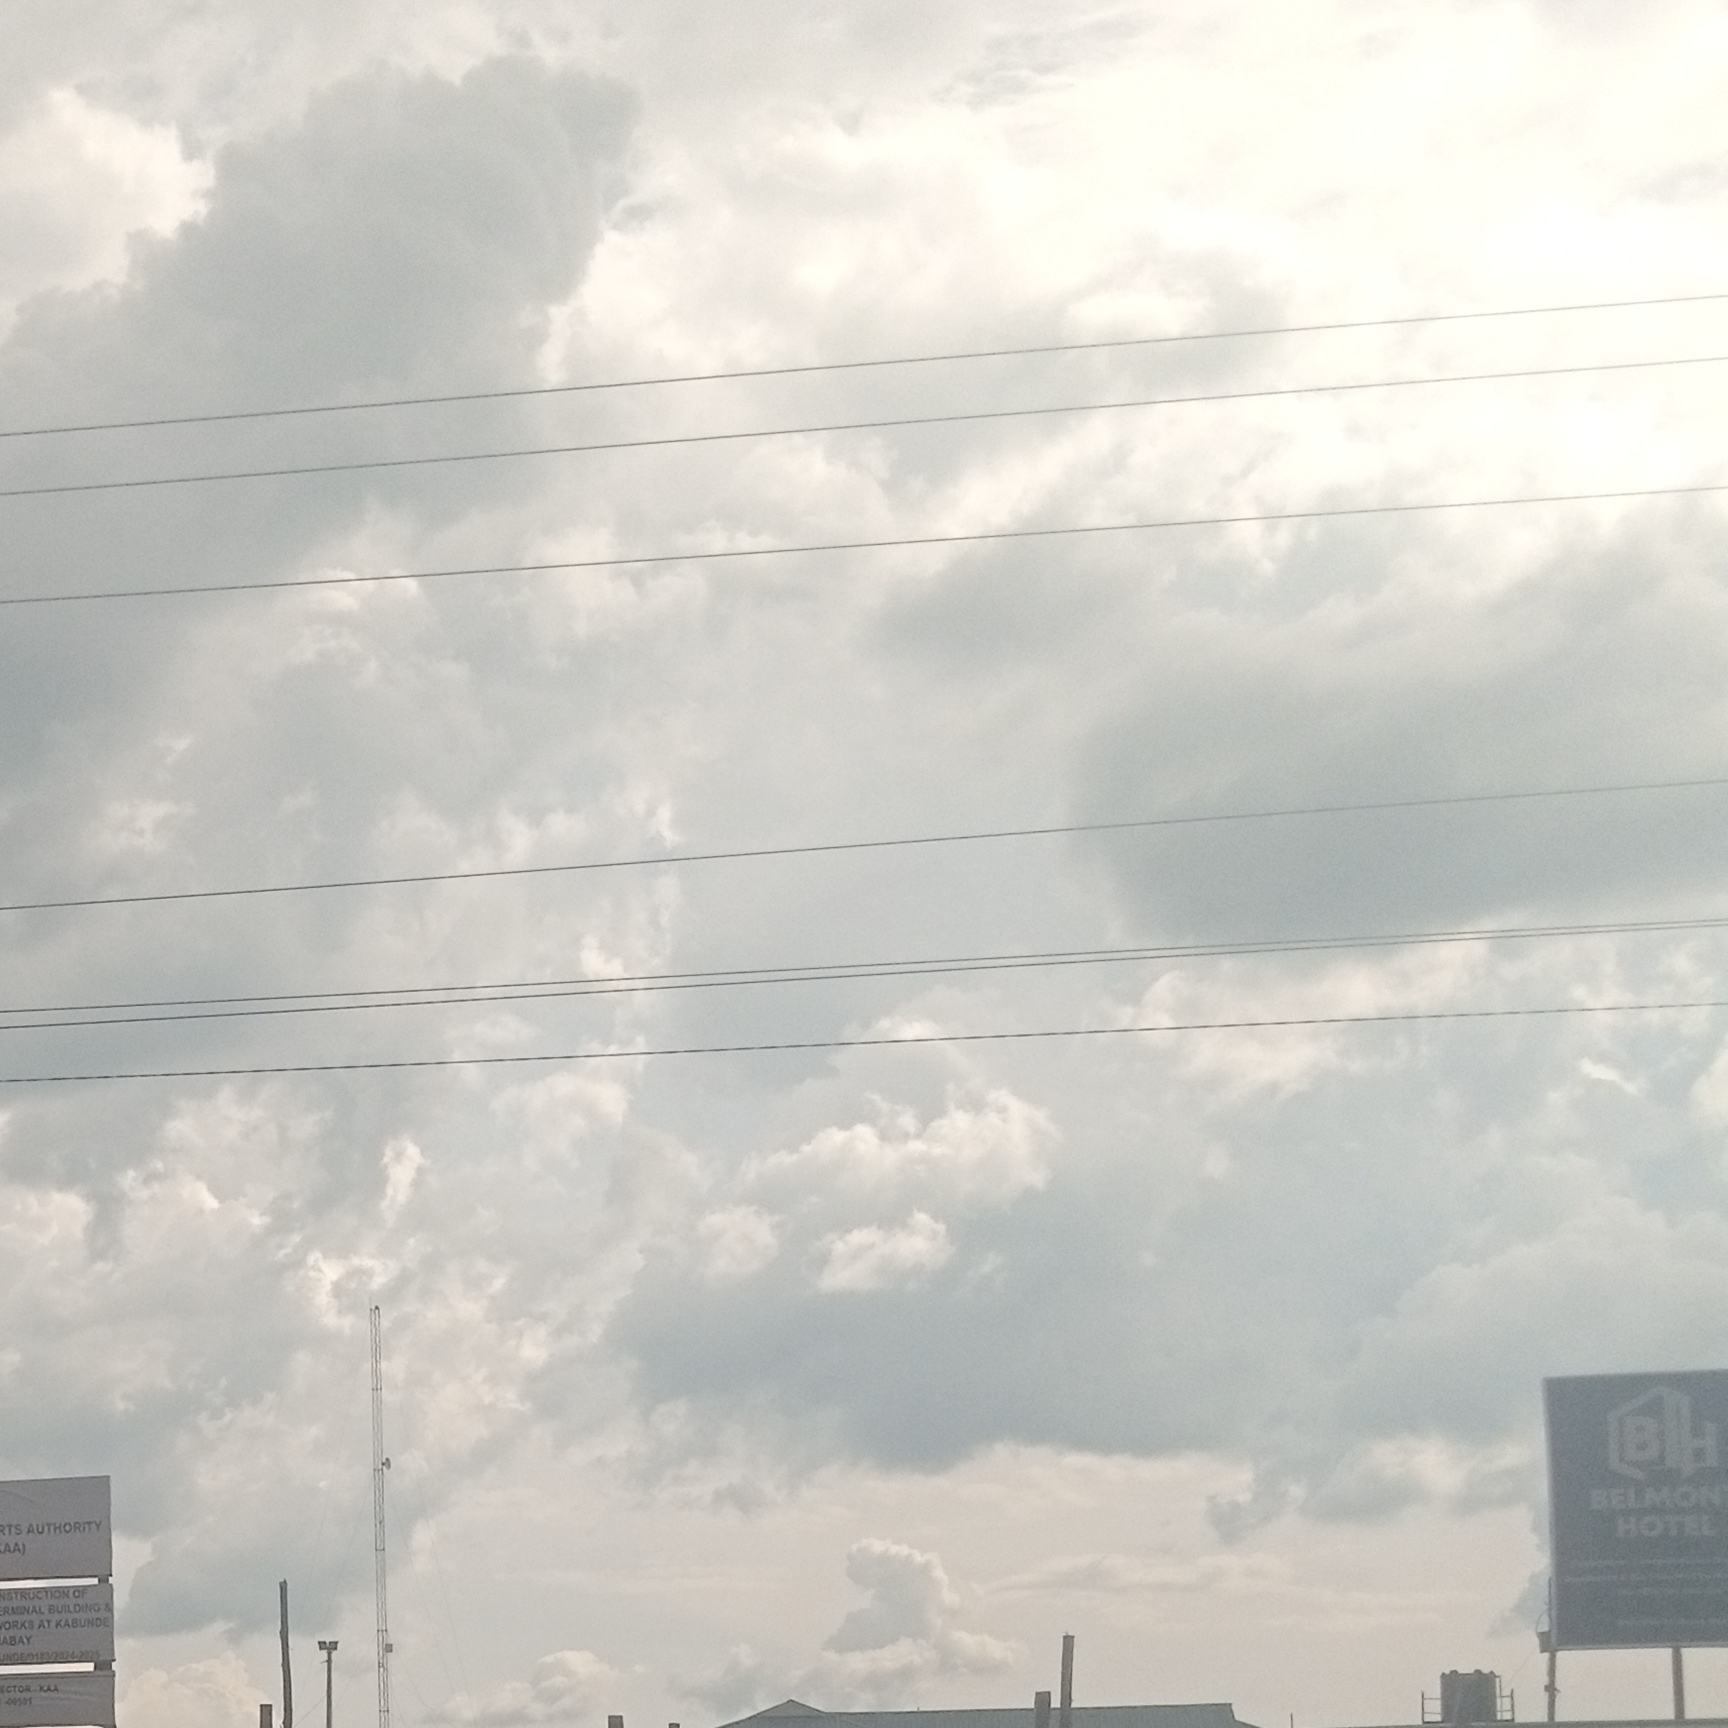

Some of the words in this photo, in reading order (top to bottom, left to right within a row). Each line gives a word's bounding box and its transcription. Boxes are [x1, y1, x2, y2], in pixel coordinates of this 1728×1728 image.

[27, 1521, 102, 1534] AUTHORITY
[1616, 1516, 1716, 1537] HOTEL
[73, 1589, 88, 1600] OF
[49, 1603, 101, 1615] BUILDING
[104, 1603, 111, 1613] &
[38, 1620, 51, 1629] AT
[55, 1617, 110, 1629] KABUNDE
[40, 1684, 59, 1693] KAA
